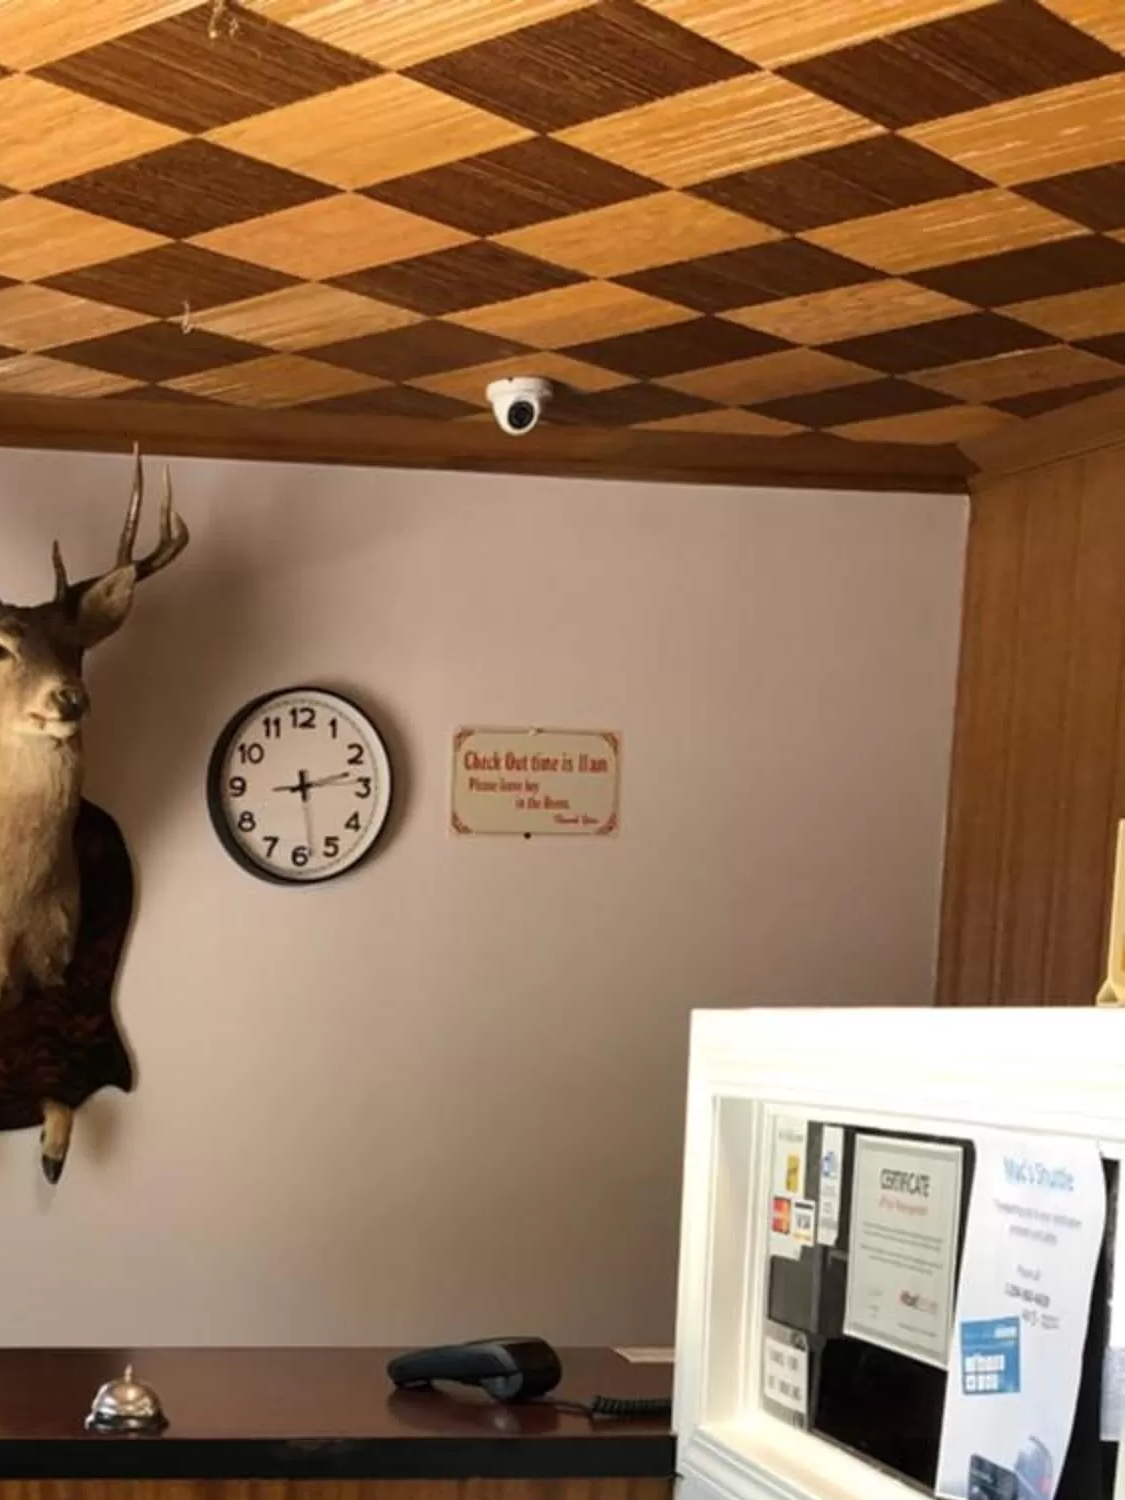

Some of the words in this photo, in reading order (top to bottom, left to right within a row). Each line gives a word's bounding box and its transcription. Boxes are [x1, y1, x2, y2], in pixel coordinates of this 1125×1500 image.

[263, 717, 282, 738] 11
[290, 708, 316, 729] 12
[329, 718, 338, 738] 1
[239, 743, 264, 765] 10
[347, 744, 364, 765] 2
[464, 750, 500, 771] Check
[505, 751, 528, 771] Out
[530, 752, 558, 772] time
[561, 752, 573, 772] is
[229, 776, 247, 797] 9
[354, 777, 372, 799] 3
[238, 811, 255, 832] 8
[344, 811, 361, 832] 4
[263, 836, 280, 858] 7
[291, 846, 309, 867] 6
[324, 837, 339, 858] 5
